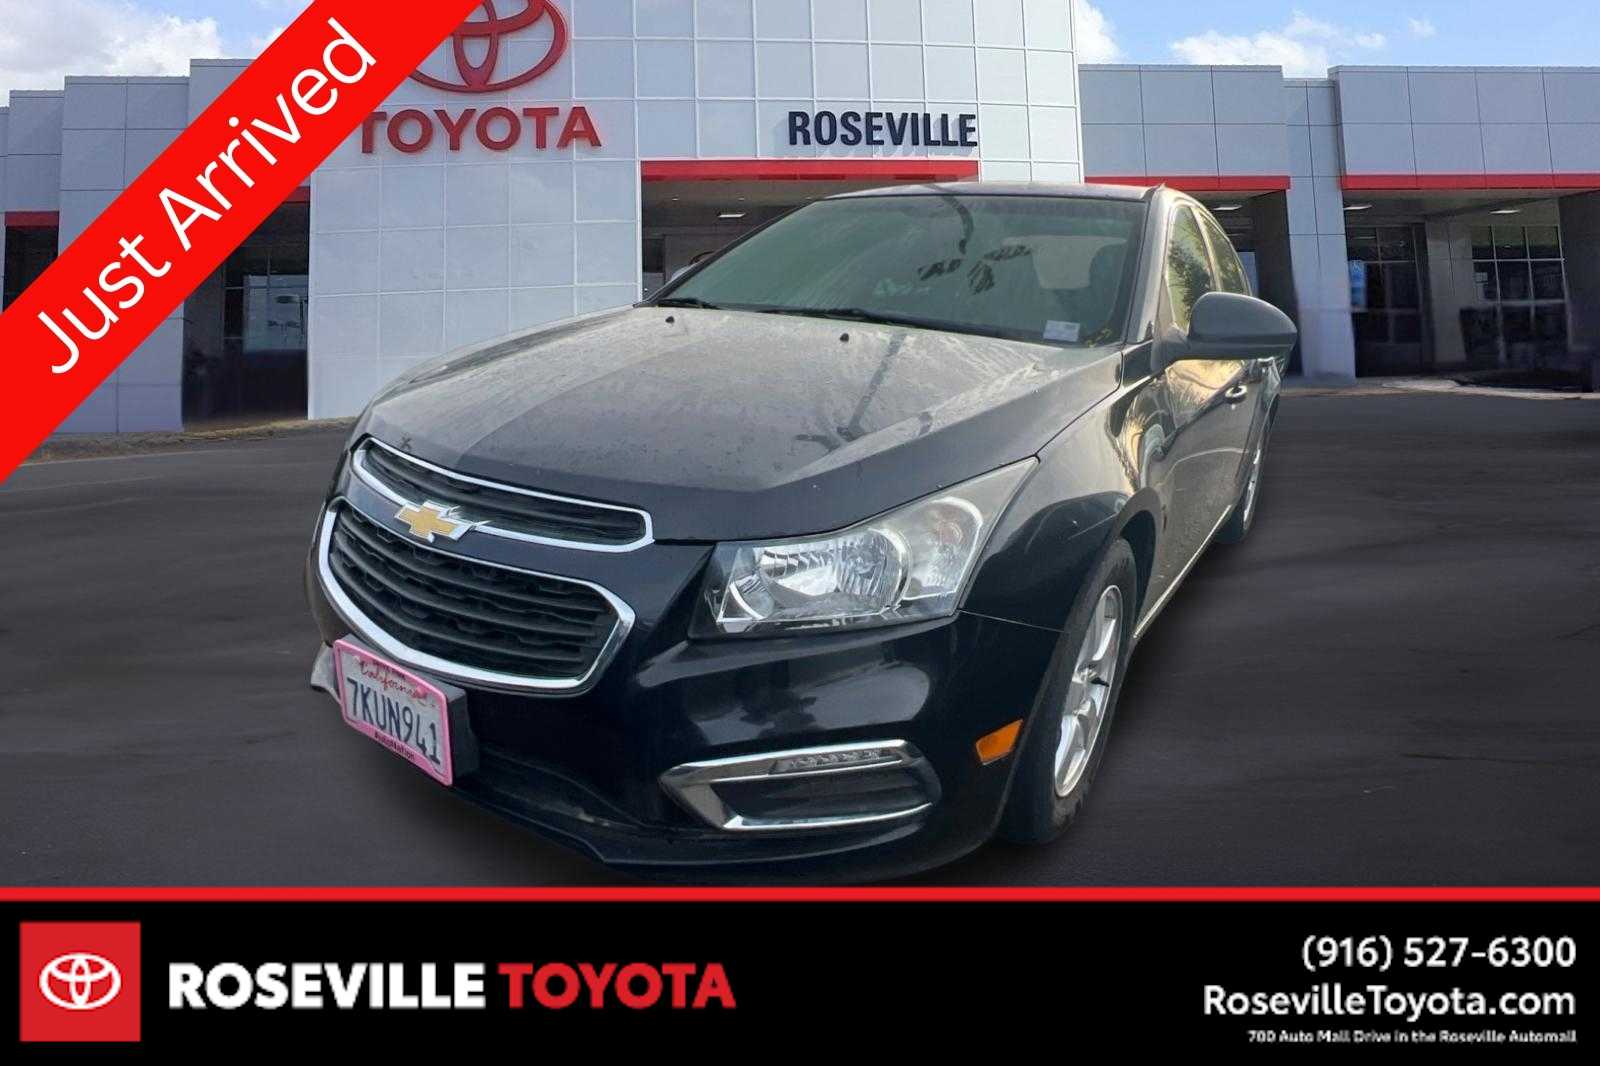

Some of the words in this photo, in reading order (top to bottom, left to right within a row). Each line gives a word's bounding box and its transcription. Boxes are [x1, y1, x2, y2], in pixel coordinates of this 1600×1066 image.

[361, 106, 602, 154] TOYOTA
[789, 111, 978, 147] ROSEVILLE
[347, 677, 441, 765] 7KUN941
